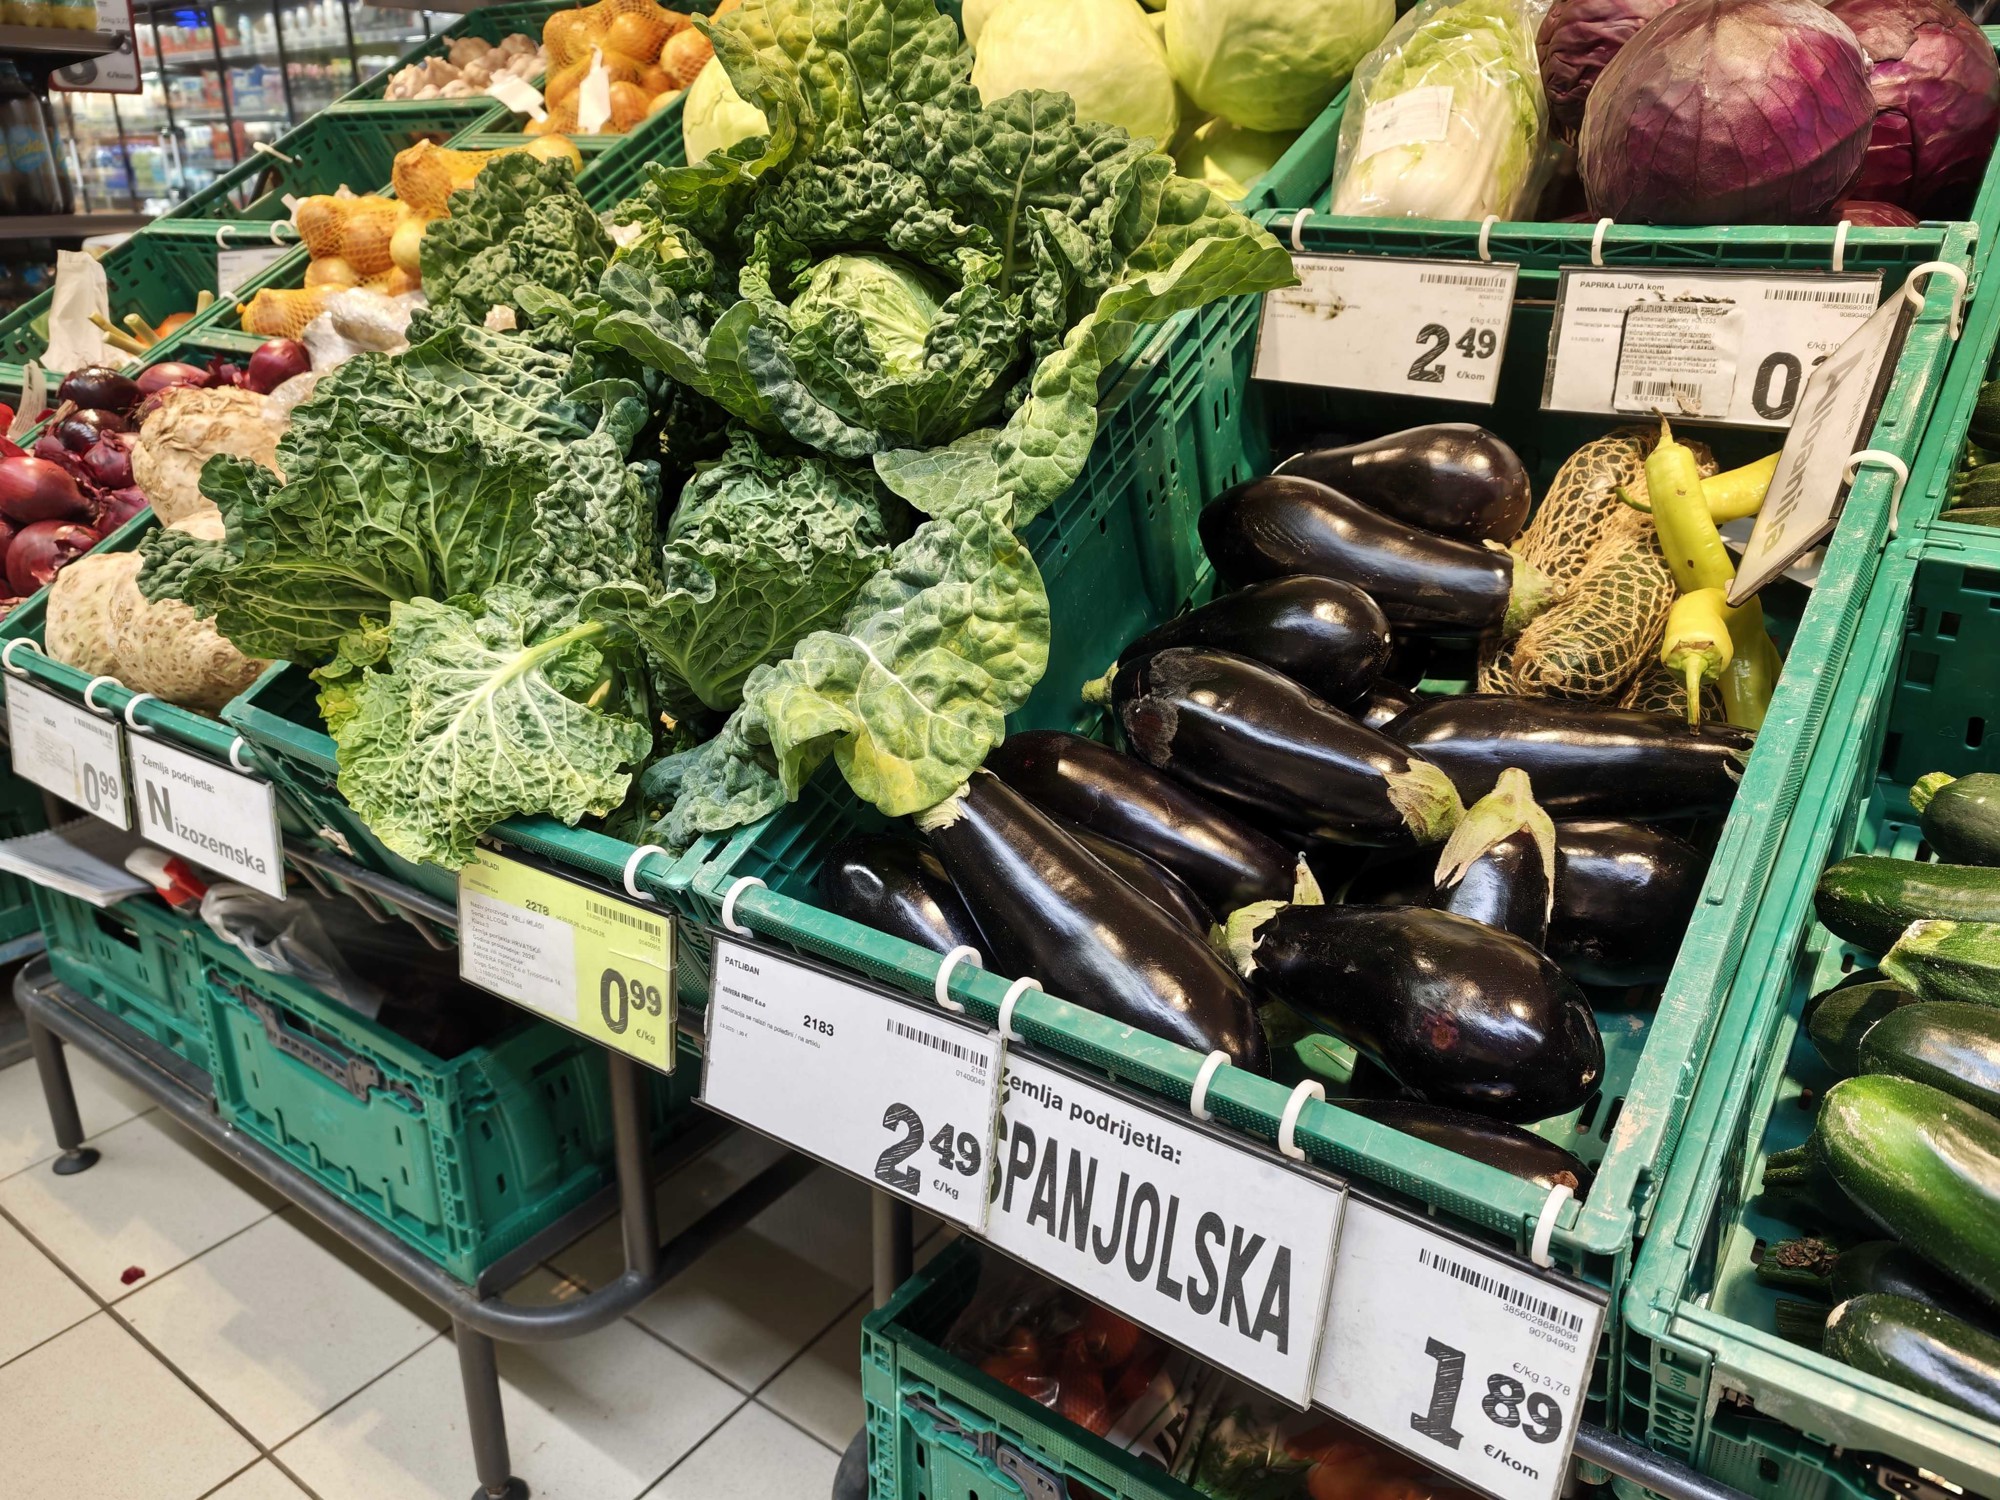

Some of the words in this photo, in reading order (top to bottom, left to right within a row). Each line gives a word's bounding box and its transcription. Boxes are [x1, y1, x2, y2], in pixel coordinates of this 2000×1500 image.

[1301, 264, 1327, 272] KINESKI
[1328, 265, 1345, 273] KOM
[1580, 281, 1615, 289] PAPRIKA
[1617, 282, 1645, 290] LJUTA
[1807, 341, 1827, 351] €/kg
[1456, 370, 1485, 382] €/kom
[1752, 351, 1803, 420] 0
[1761, 348, 1865, 558] Albanija
[142, 754, 169, 775] Zemlja
[171, 768, 215, 793] podrijetla:
[145, 778, 266, 875] Nizozemska
[525, 899, 550, 917] 2278
[724, 956, 760, 976] PATLIĐAN
[600, 967, 628, 1035] 0
[630, 979, 662, 1017] 99
[636, 1028, 656, 1045] €/kg
[803, 1014, 834, 1037] 2183
[956, 1069, 985, 1087] 01400049
[971, 1065, 986, 1077] 2183
[1000, 1067, 1063, 1111] Zemlja
[1070, 1103, 1182, 1165] podrijetla:
[875, 1102, 924, 1196] 2
[929, 1123, 982, 1177] 49
[932, 1178, 959, 1200] €/kg
[1502, 1302, 1579, 1343] 3856028689096
[1528, 1325, 1577, 1354] 90794993
[1512, 1361, 1540, 1384] €/kg
[1543, 1375, 1571, 1396] 3,78
[1410, 1336, 1466, 1451] 1
[1481, 1373, 1563, 1444] 89
[1483, 1443, 1539, 1480] €/kom
